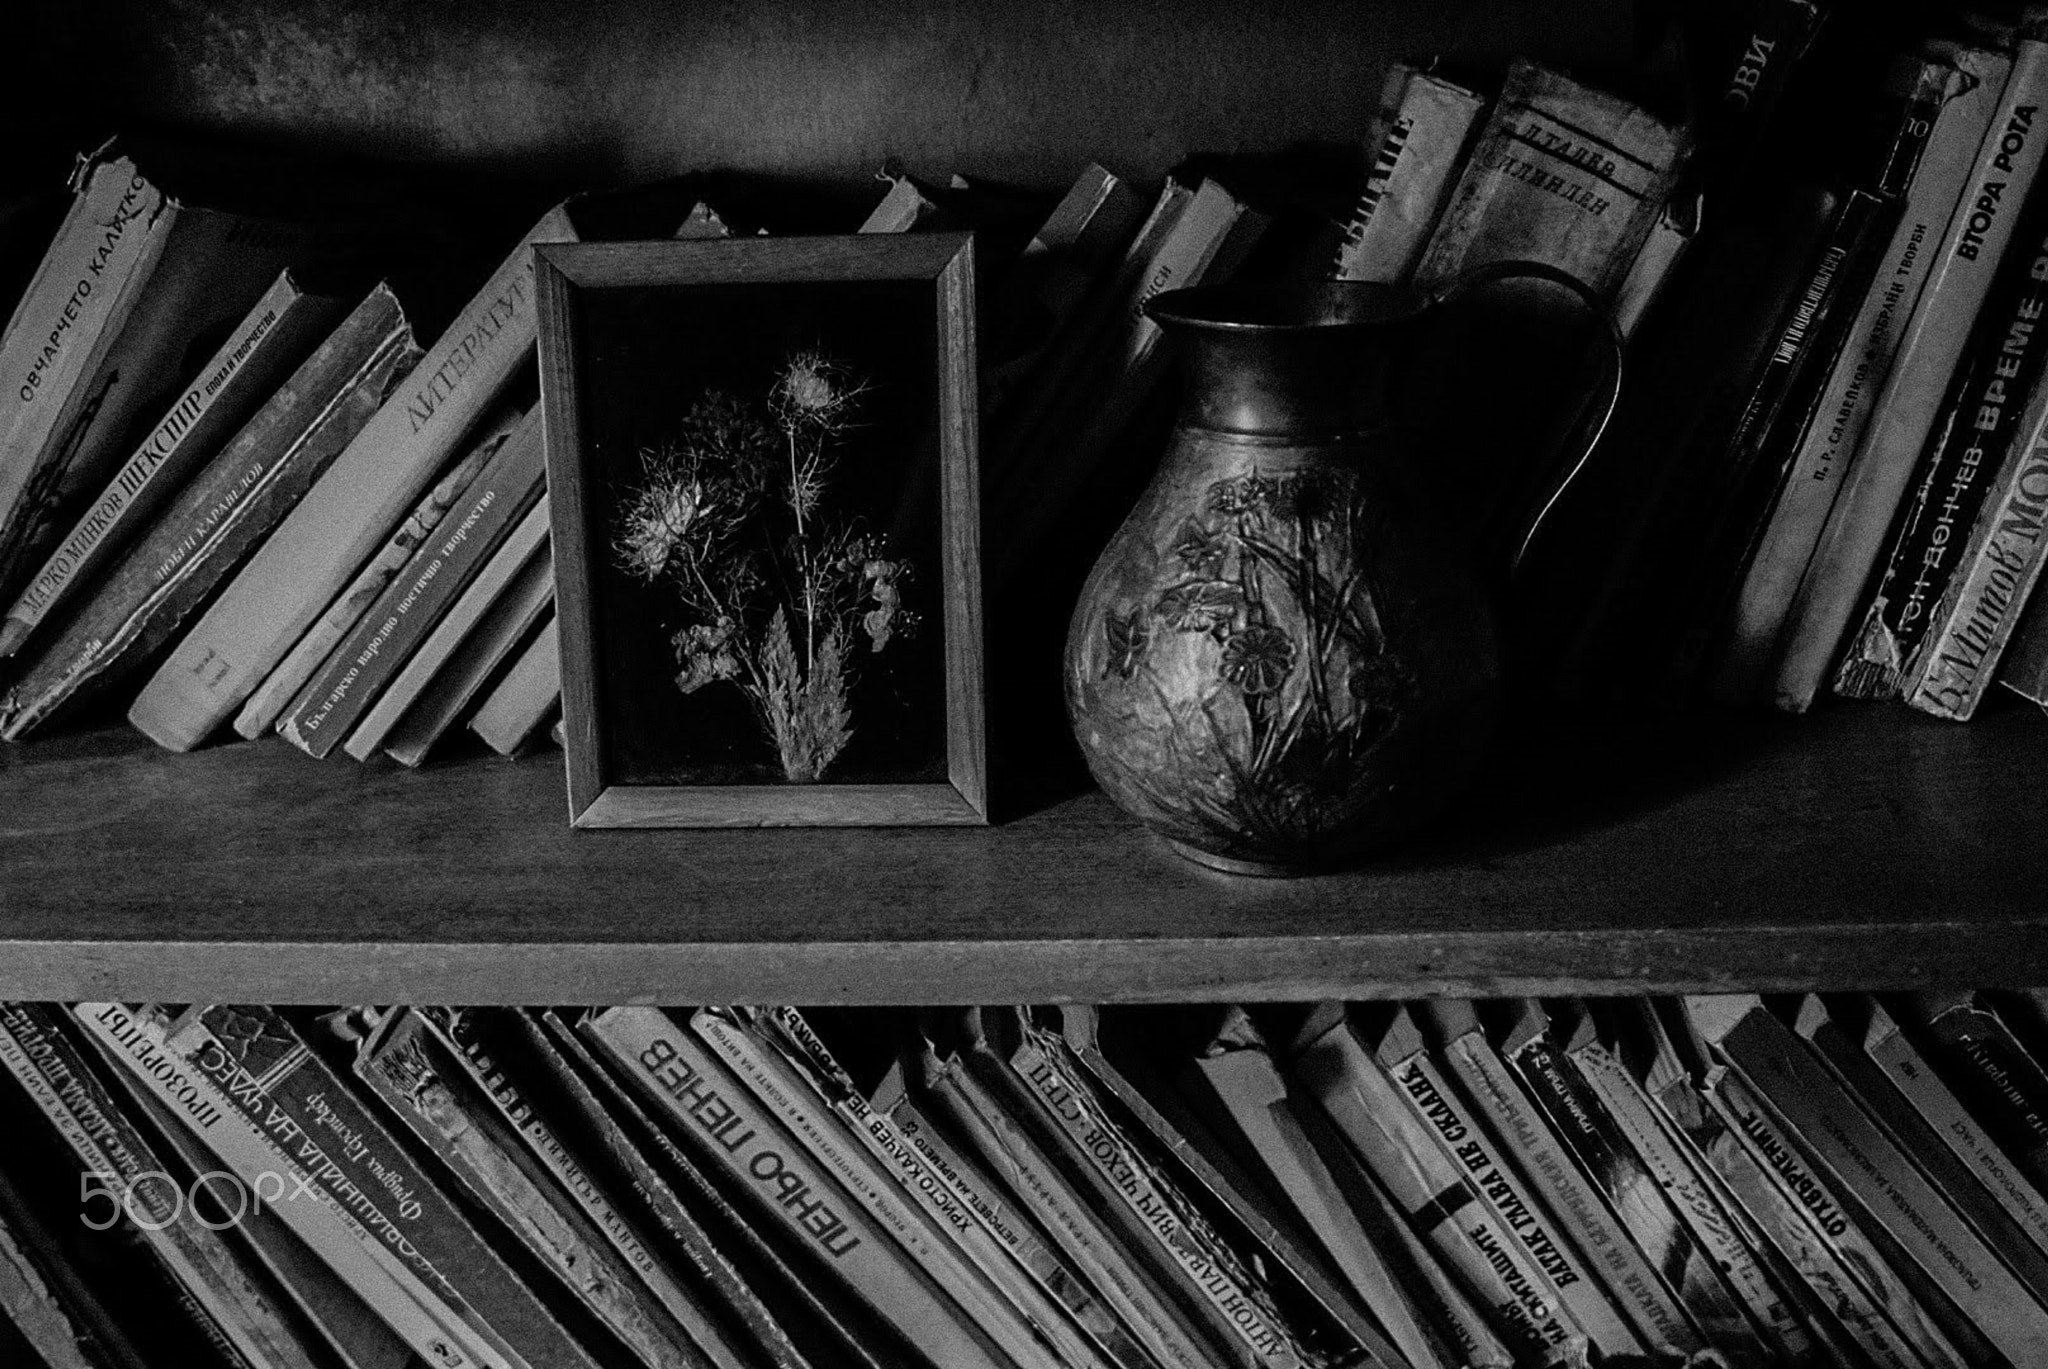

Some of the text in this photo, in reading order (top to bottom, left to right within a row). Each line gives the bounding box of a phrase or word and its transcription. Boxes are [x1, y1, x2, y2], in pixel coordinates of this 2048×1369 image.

[1956, 99, 2038, 262] ВТОРА РОТА
[1896, 222, 1926, 278] ТВОРБИ
[15, 277, 95, 404] ОВЧАРЧЕТО
[19, 555, 74, 616] МАРКО
[62, 490, 126, 563] МИНКОВ
[115, 388, 209, 496] ШЕКСПИР
[203, 365, 231, 396] ЕПОХА
[231, 309, 277, 363] ТВОРЧЕСТВО
[1921, 443, 1984, 569] ДОНЧЕВ
[1971, 294, 2043, 435] ВРЕМЕ
[440, 488, 497, 557] творчество
[261, 1103, 301, 1144] НА
[640, 1038, 755, 1154] ПЕНЕВ
[867, 1119, 924, 1179] КАЛЧЕВ
[912, 1136, 958, 1183] ВРЕМЕТО
[1083, 1128, 1142, 1196] ЧЕХОВ
[1455, 1137, 1491, 1175] НЕ
[365, 1155, 426, 1224] Фридрих
[537, 1130, 655, 1273] ДИМИТЪР МАНТОВ
[749, 1150, 861, 1258] ПЕНЬО
[916, 1174, 974, 1233] ХРИСТО
[1477, 1168, 1535, 1234] ГЛАВА
[1136, 1191, 1230, 1297] ПАВВИЧ
[1520, 1223, 1579, 1291] БАТАК
[1219, 1291, 1283, 1360] АНТОН
[1540, 1316, 1569, 1346] НА
